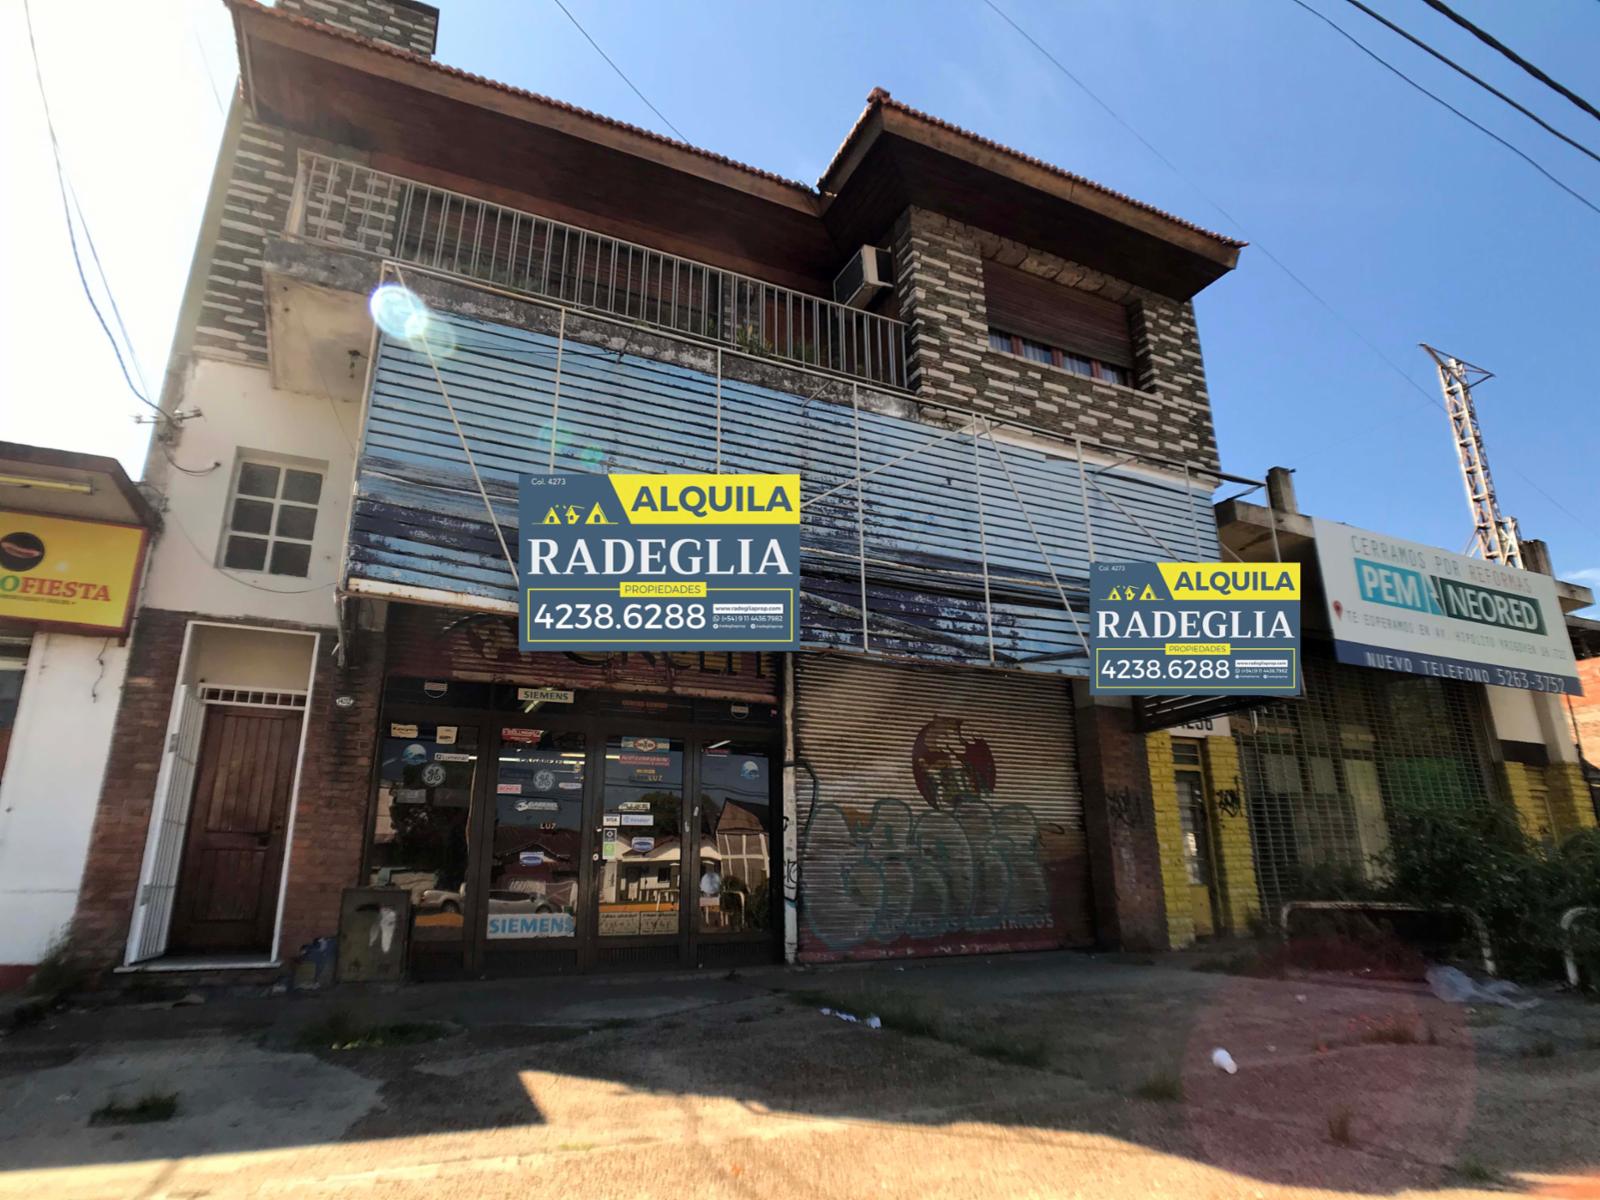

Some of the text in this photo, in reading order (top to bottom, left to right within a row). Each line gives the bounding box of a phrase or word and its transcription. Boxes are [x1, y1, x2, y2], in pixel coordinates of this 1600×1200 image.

[1351, 535, 1532, 593] CERRAMOS POR REFORMAS
[1361, 564, 1538, 631] PEM NEORED
[1364, 652, 1565, 693] NUEVO TELEFONO 5263-3752
[523, 690, 569, 701] SIEMENS
[489, 917, 575, 933] SIEMENS
